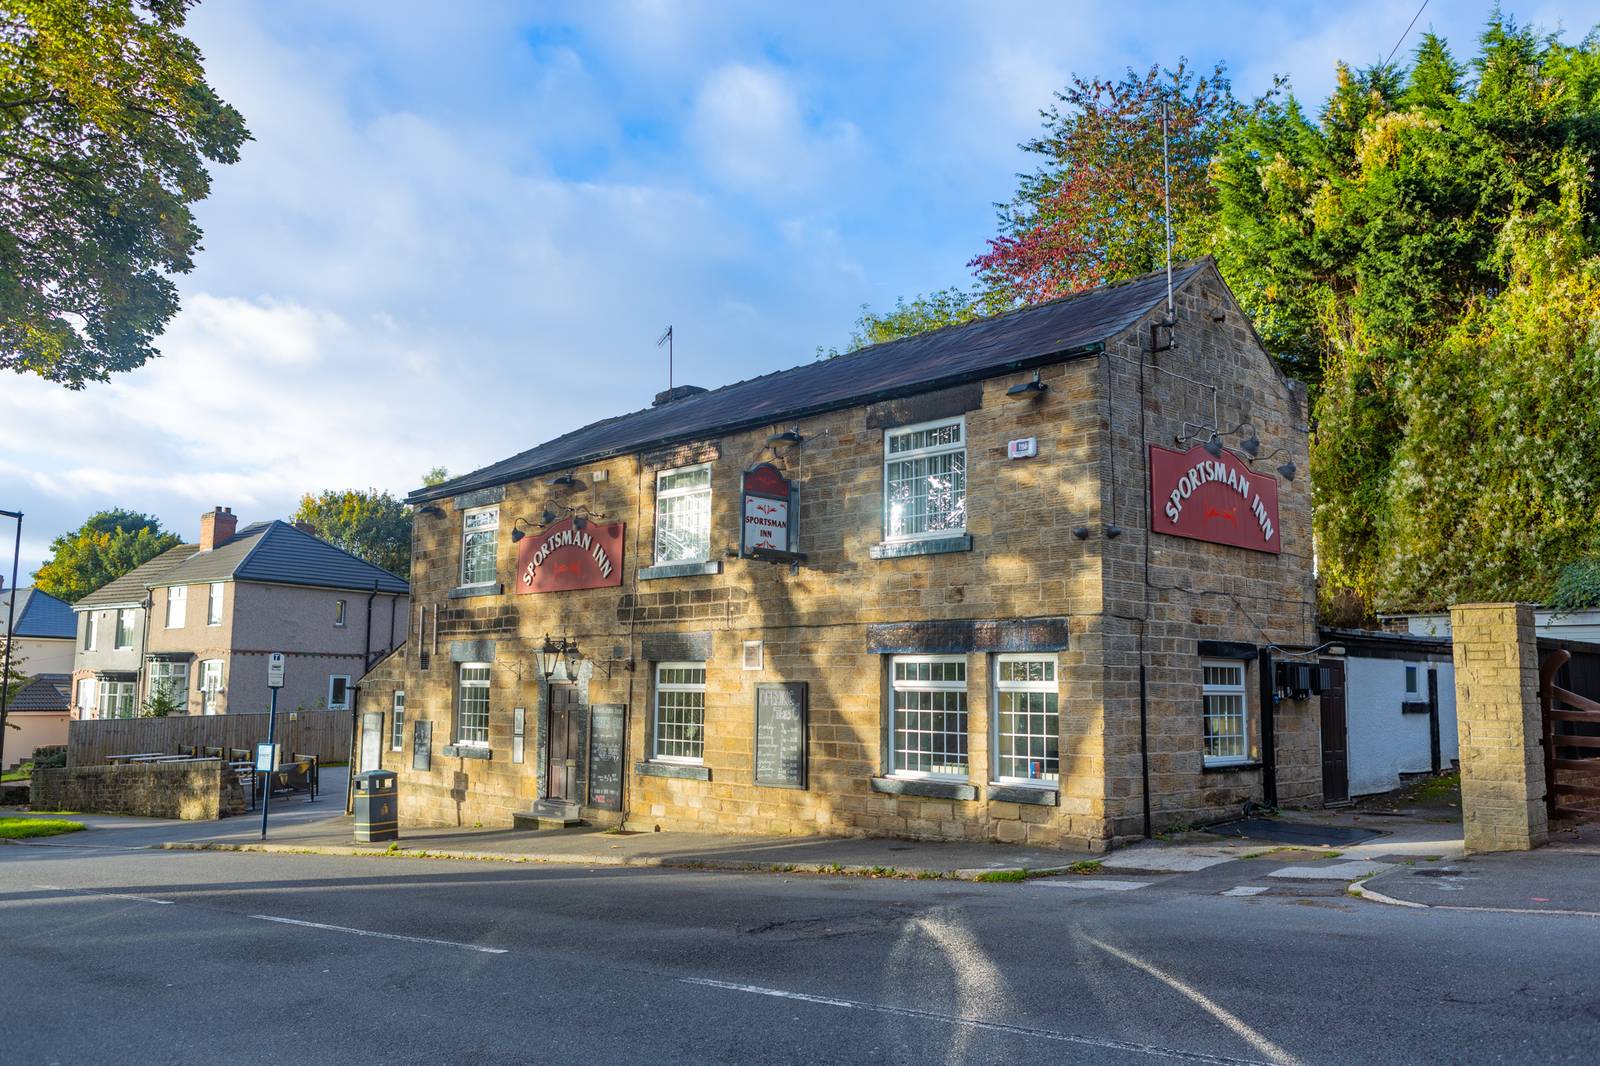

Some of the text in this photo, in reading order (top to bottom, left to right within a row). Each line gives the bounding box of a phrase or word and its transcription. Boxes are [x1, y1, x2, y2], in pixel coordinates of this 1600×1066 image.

[1165, 460, 1275, 542] SPORTSMAN INN
[745, 515, 787, 529] SPORTSMAN
[760, 529, 773, 538] INN
[522, 529, 614, 587] SPORTSMAN INN
